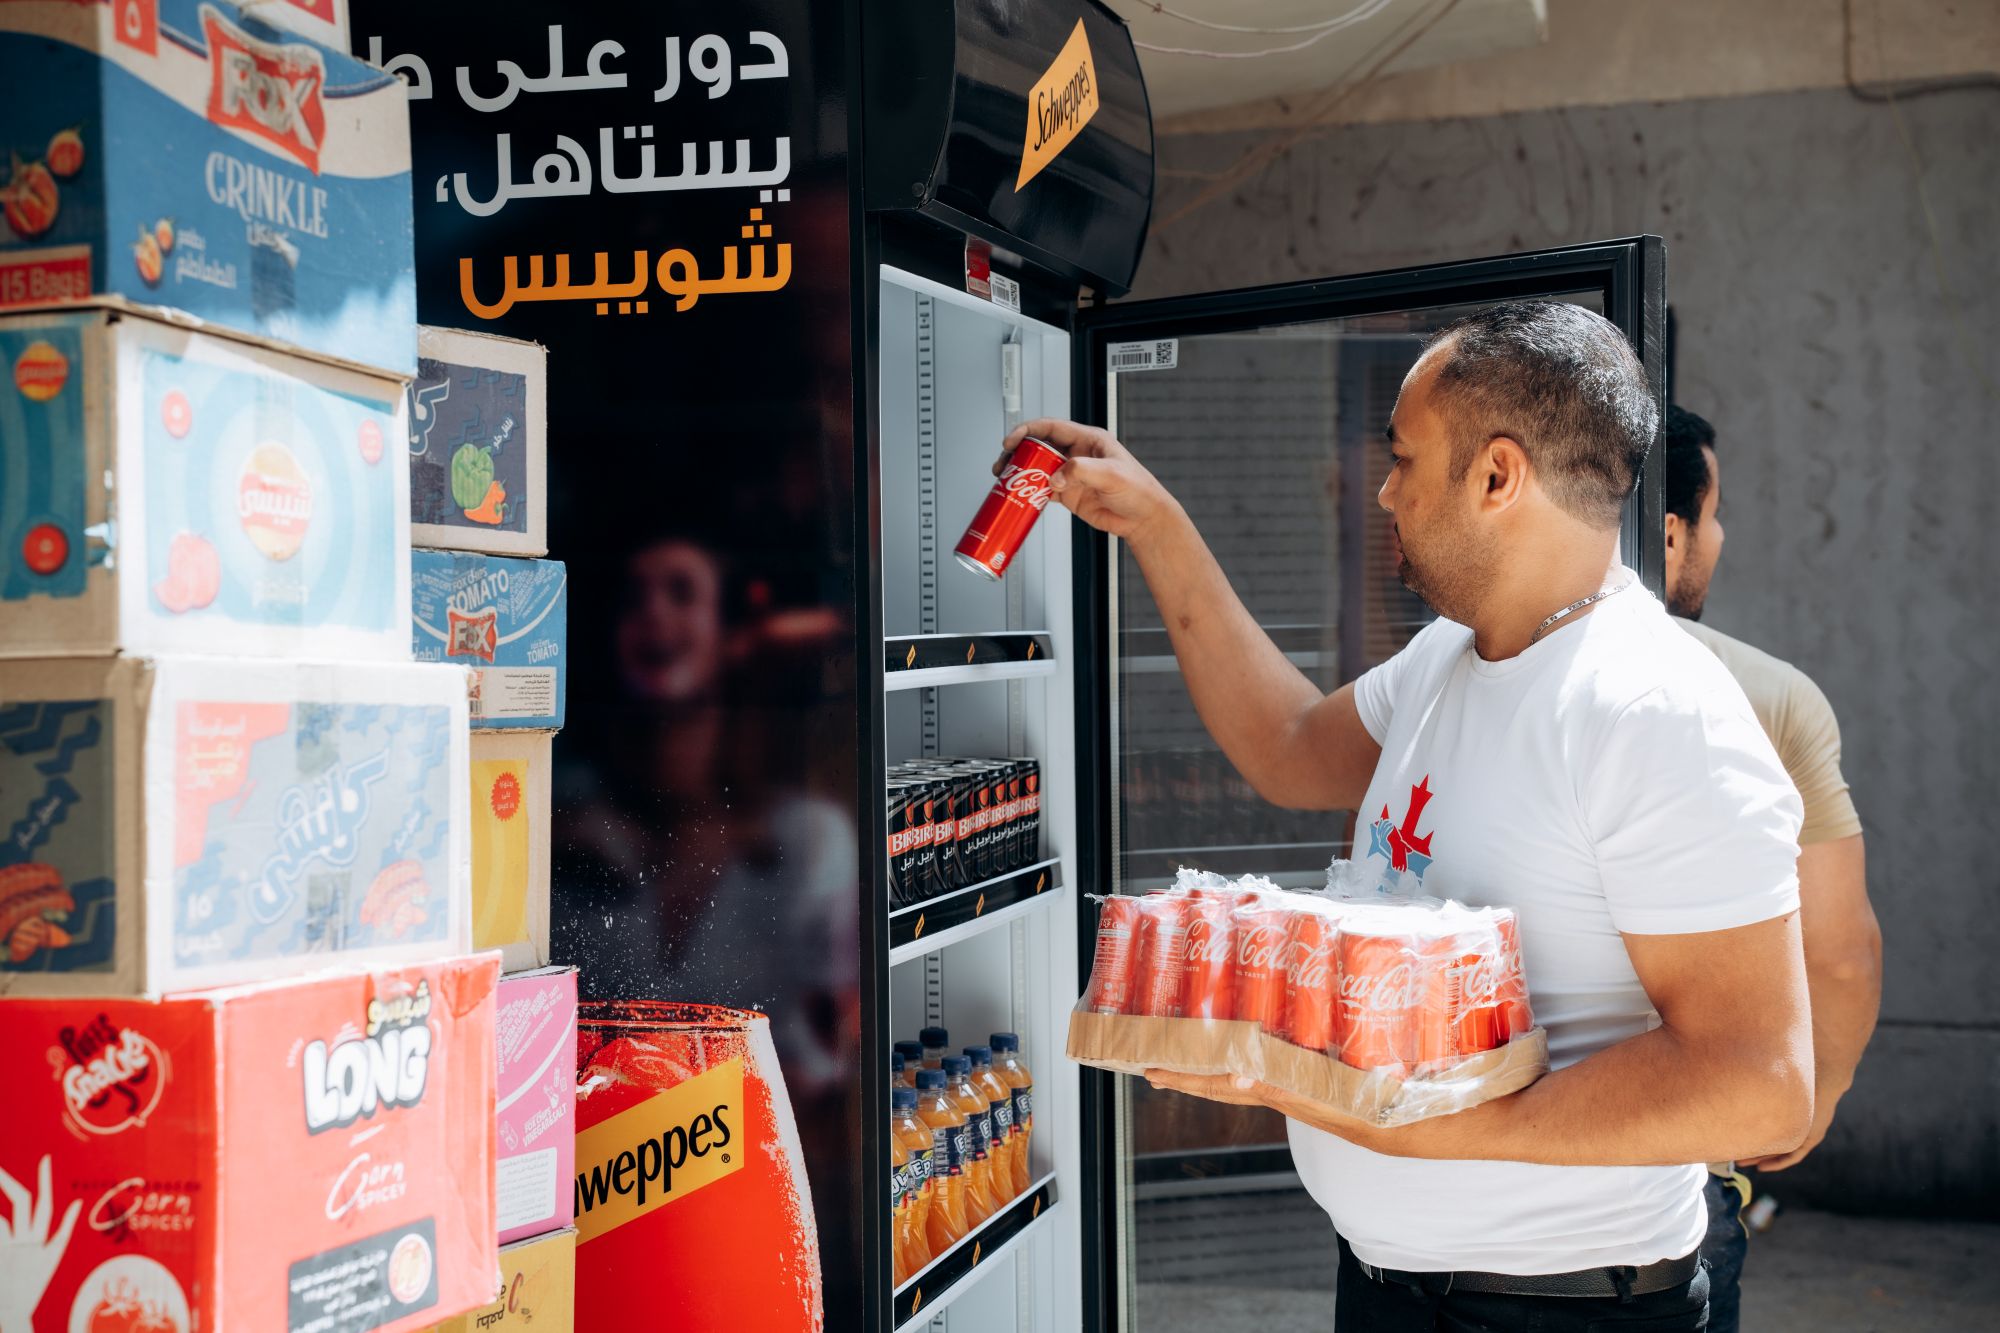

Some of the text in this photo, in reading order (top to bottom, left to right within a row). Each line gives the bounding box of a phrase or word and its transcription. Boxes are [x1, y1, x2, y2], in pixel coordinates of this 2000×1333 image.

[456, 25, 628, 113] على
[655, 31, 789, 102] دور
[221, 46, 318, 151] FOX
[1034, 61, 1091, 152] Schweppes
[436, 125, 792, 217] يستاهل،
[205, 152, 328, 239] CRINKLE
[1, 265, 86, 304] 15 Bags
[459, 208, 792, 320] شويبس
[447, 568, 509, 612] TOMATO
[454, 619, 495, 652] FOX
[527, 643, 559, 664] TOMATO
[893, 830, 914, 852] BIR
[935, 821, 954, 842] BIR
[1184, 918, 1233, 962] Cola
[304, 1025, 432, 1130] LONG
[574, 1104, 731, 1214] weppes
[357, 1181, 408, 1210] SPICEY
[128, 1213, 195, 1231] SPICEY
[476, 1304, 505, 1330] بطعم
